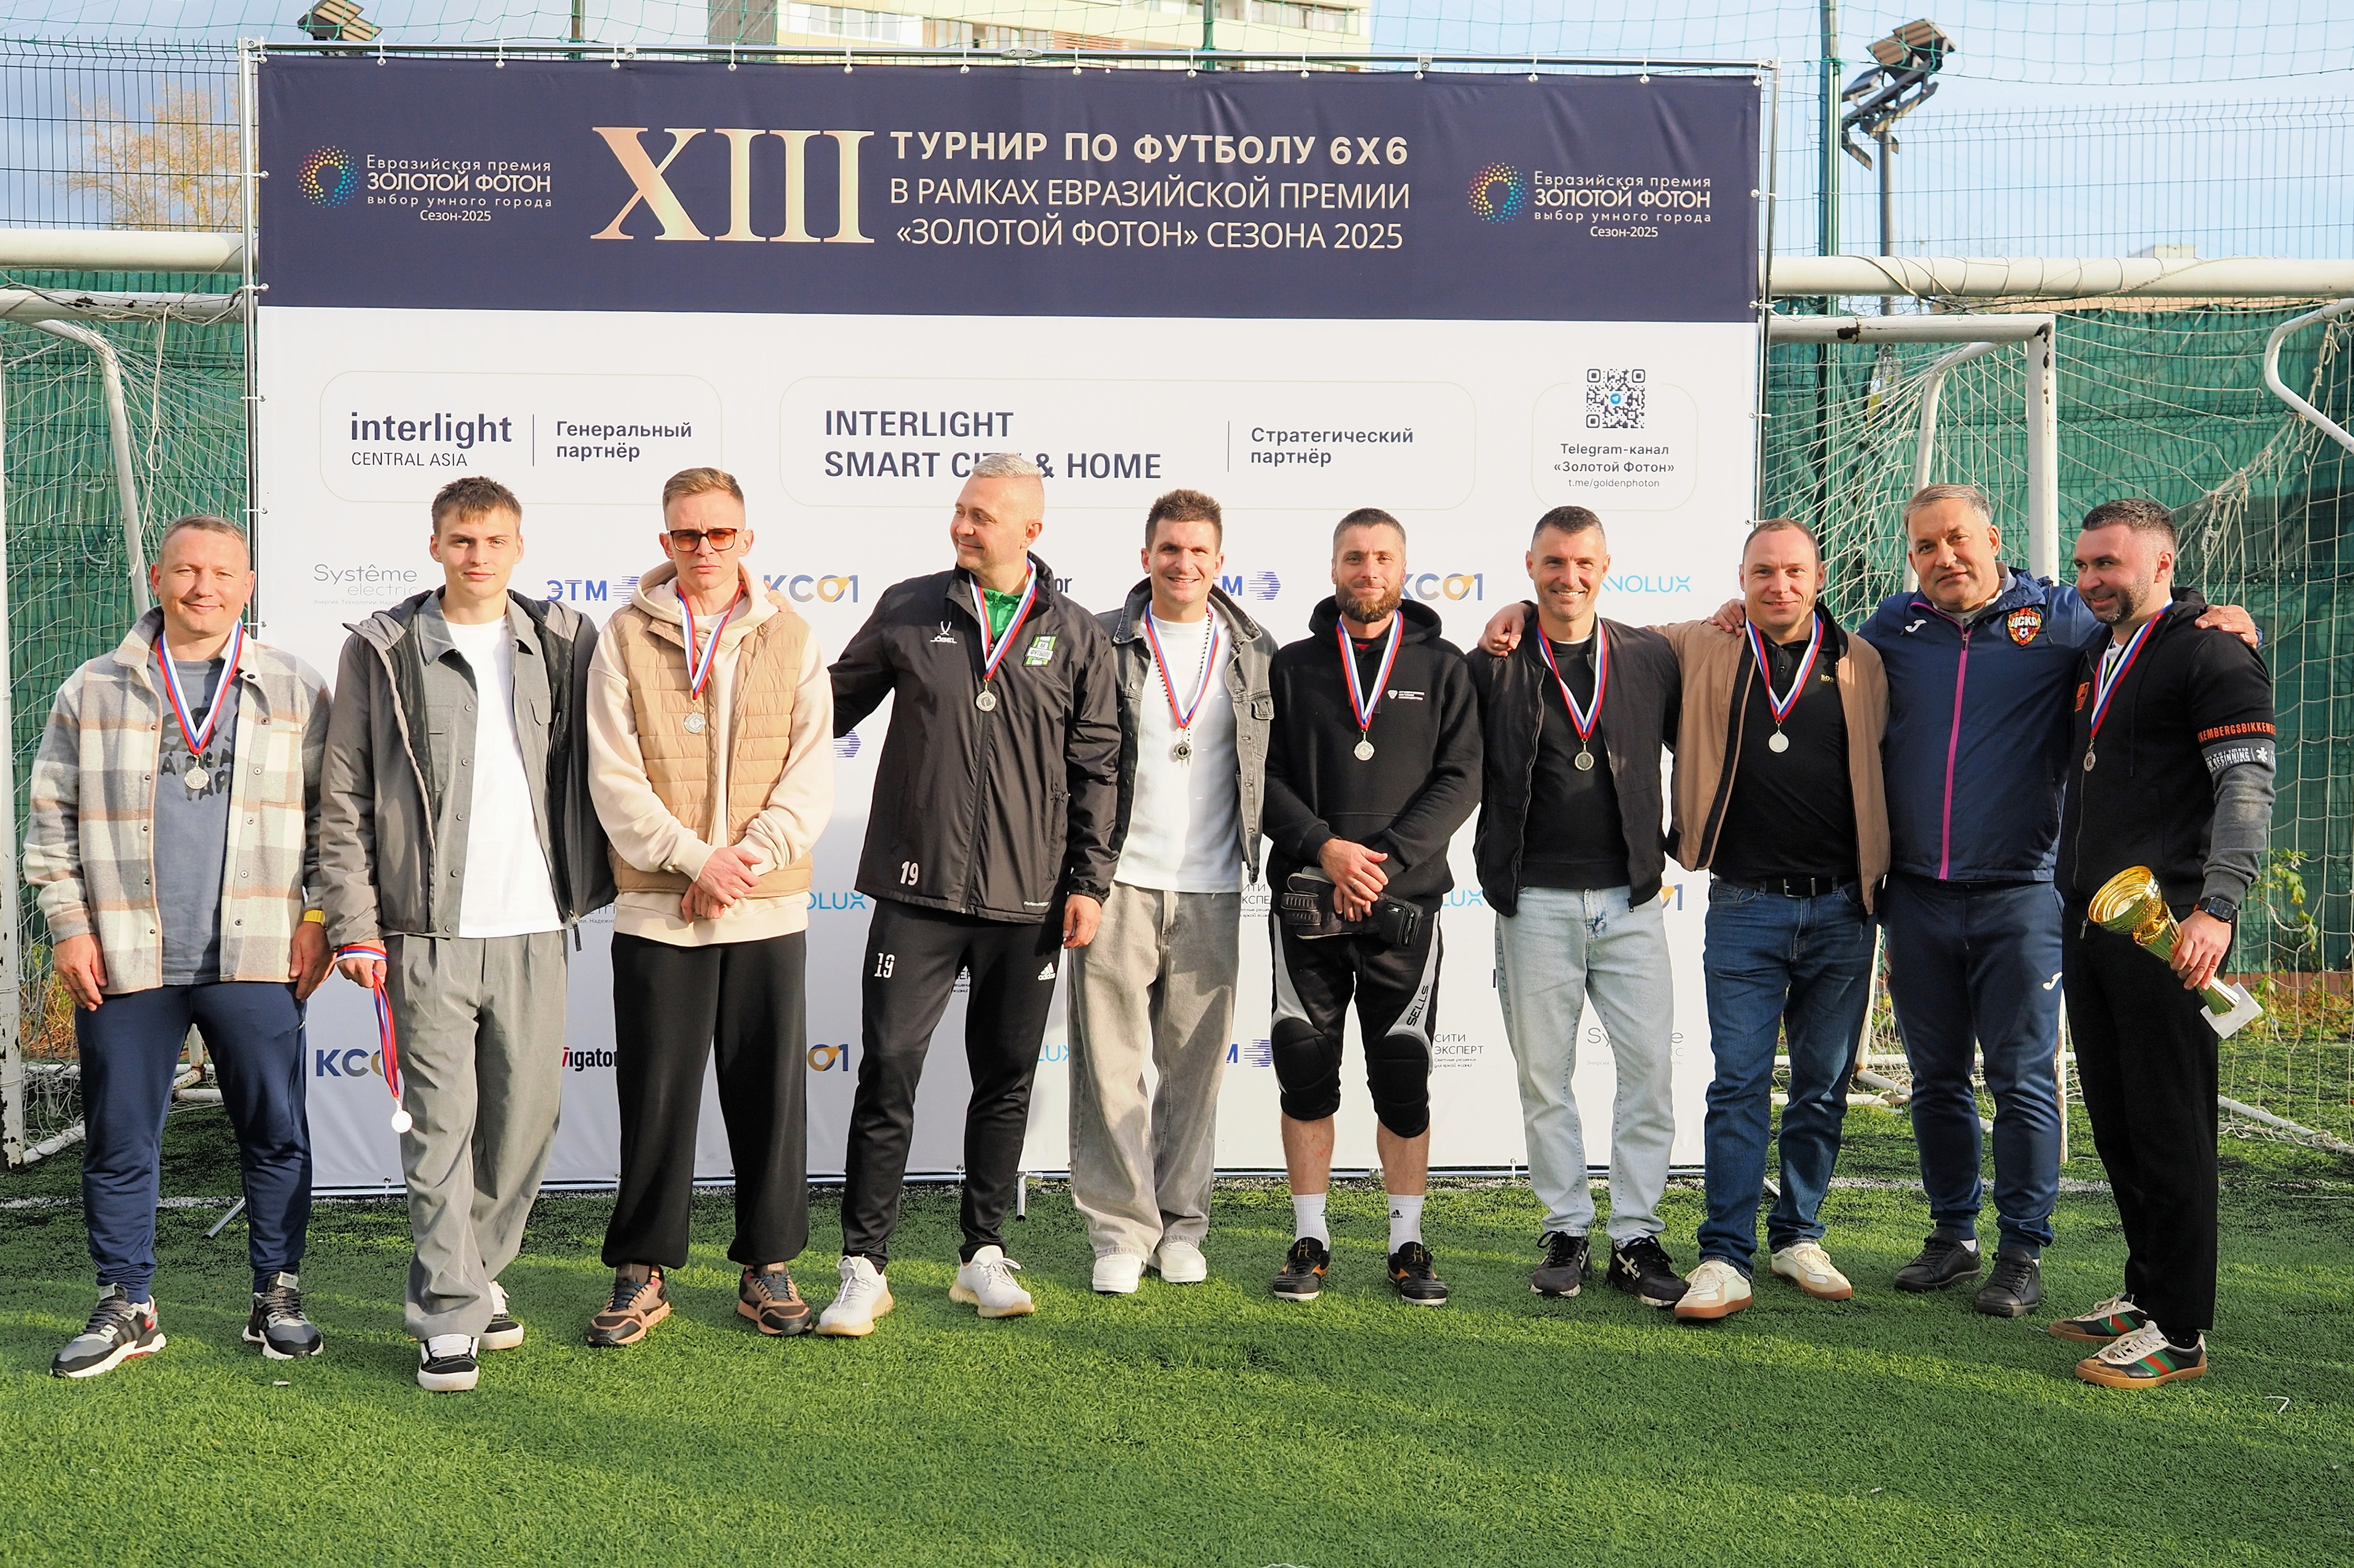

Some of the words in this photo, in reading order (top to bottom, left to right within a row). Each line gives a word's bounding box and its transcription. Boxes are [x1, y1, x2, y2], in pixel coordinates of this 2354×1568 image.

[890, 132, 1047, 160] ТУРНИР
[1066, 133, 1117, 161] ПО
[1134, 134, 1315, 164] ФУТБОЛУ
[367, 155, 480, 172] Евразийская
[489, 162, 550, 173] премия
[368, 169, 468, 191] ЗОЛОТОЙ
[476, 172, 550, 192] ФОТОН
[591, 127, 874, 243] XIII
[1535, 171, 1643, 188] Евразийская
[1650, 178, 1710, 190] премия
[891, 178, 908, 203] В
[919, 179, 1039, 204] РАМКАХ
[1049, 174, 1269, 208] ЕВРАЗИЙСКОЙ
[1281, 183, 1408, 208] ПРЕМИИ
[1535, 187, 1631, 207] ЗОЛОТОЙ
[1638, 189, 1710, 208] ФОТОН
[368, 194, 418, 207] выбор
[427, 198, 486, 208] умного
[495, 199, 551, 209] города
[421, 210, 491, 221] Сезон-2025
[1535, 210, 1583, 223] выбор
[1592, 213, 1648, 223] умного
[1657, 214, 1710, 224] города
[897, 213, 1061, 245] «ЗОЛОТОЙ
[1073, 220, 1198, 246] ФОТОН»
[1207, 222, 1326, 248] СЕЗОНА
[1334, 223, 1402, 248] 2025
[1591, 226, 1658, 237] Сезон-2025
[352, 412, 512, 449] interlight
[558, 421, 691, 440] Генеральный
[827, 411, 1013, 437] INTERLIGHT
[1252, 427, 1412, 446] Стратегический
[352, 452, 424, 465] CENTRAL
[430, 453, 468, 466] ASIA
[558, 442, 639, 462] партнёр
[1252, 448, 1331, 467] партнёр
[1561, 444, 1668, 457] Telegram-канал
[825, 451, 940, 476] SMART
[1037, 453, 1055, 478] &
[1068, 453, 1160, 478] HOME
[1554, 461, 1619, 472] «Золотой
[1624, 462, 1674, 472] Фотон»
[1569, 479, 1659, 488] t.me/goldenphoton
[314, 564, 417, 585] Systême
[547, 580, 607, 601] ЭТМ
[2010, 616, 2039, 629] ЦСКА
[900, 861, 919, 886] 19
[1242, 883, 1266, 892] ИТИ
[1242, 895, 1271, 904] КСПЕ
[874, 952, 896, 979] 19
[1038, 972, 1056, 981] adidas
[1406, 985, 1430, 1027] SELLS
[1434, 1033, 1466, 1042] СИТИ
[1434, 1046, 1484, 1054] ЭКСПЕРТ
